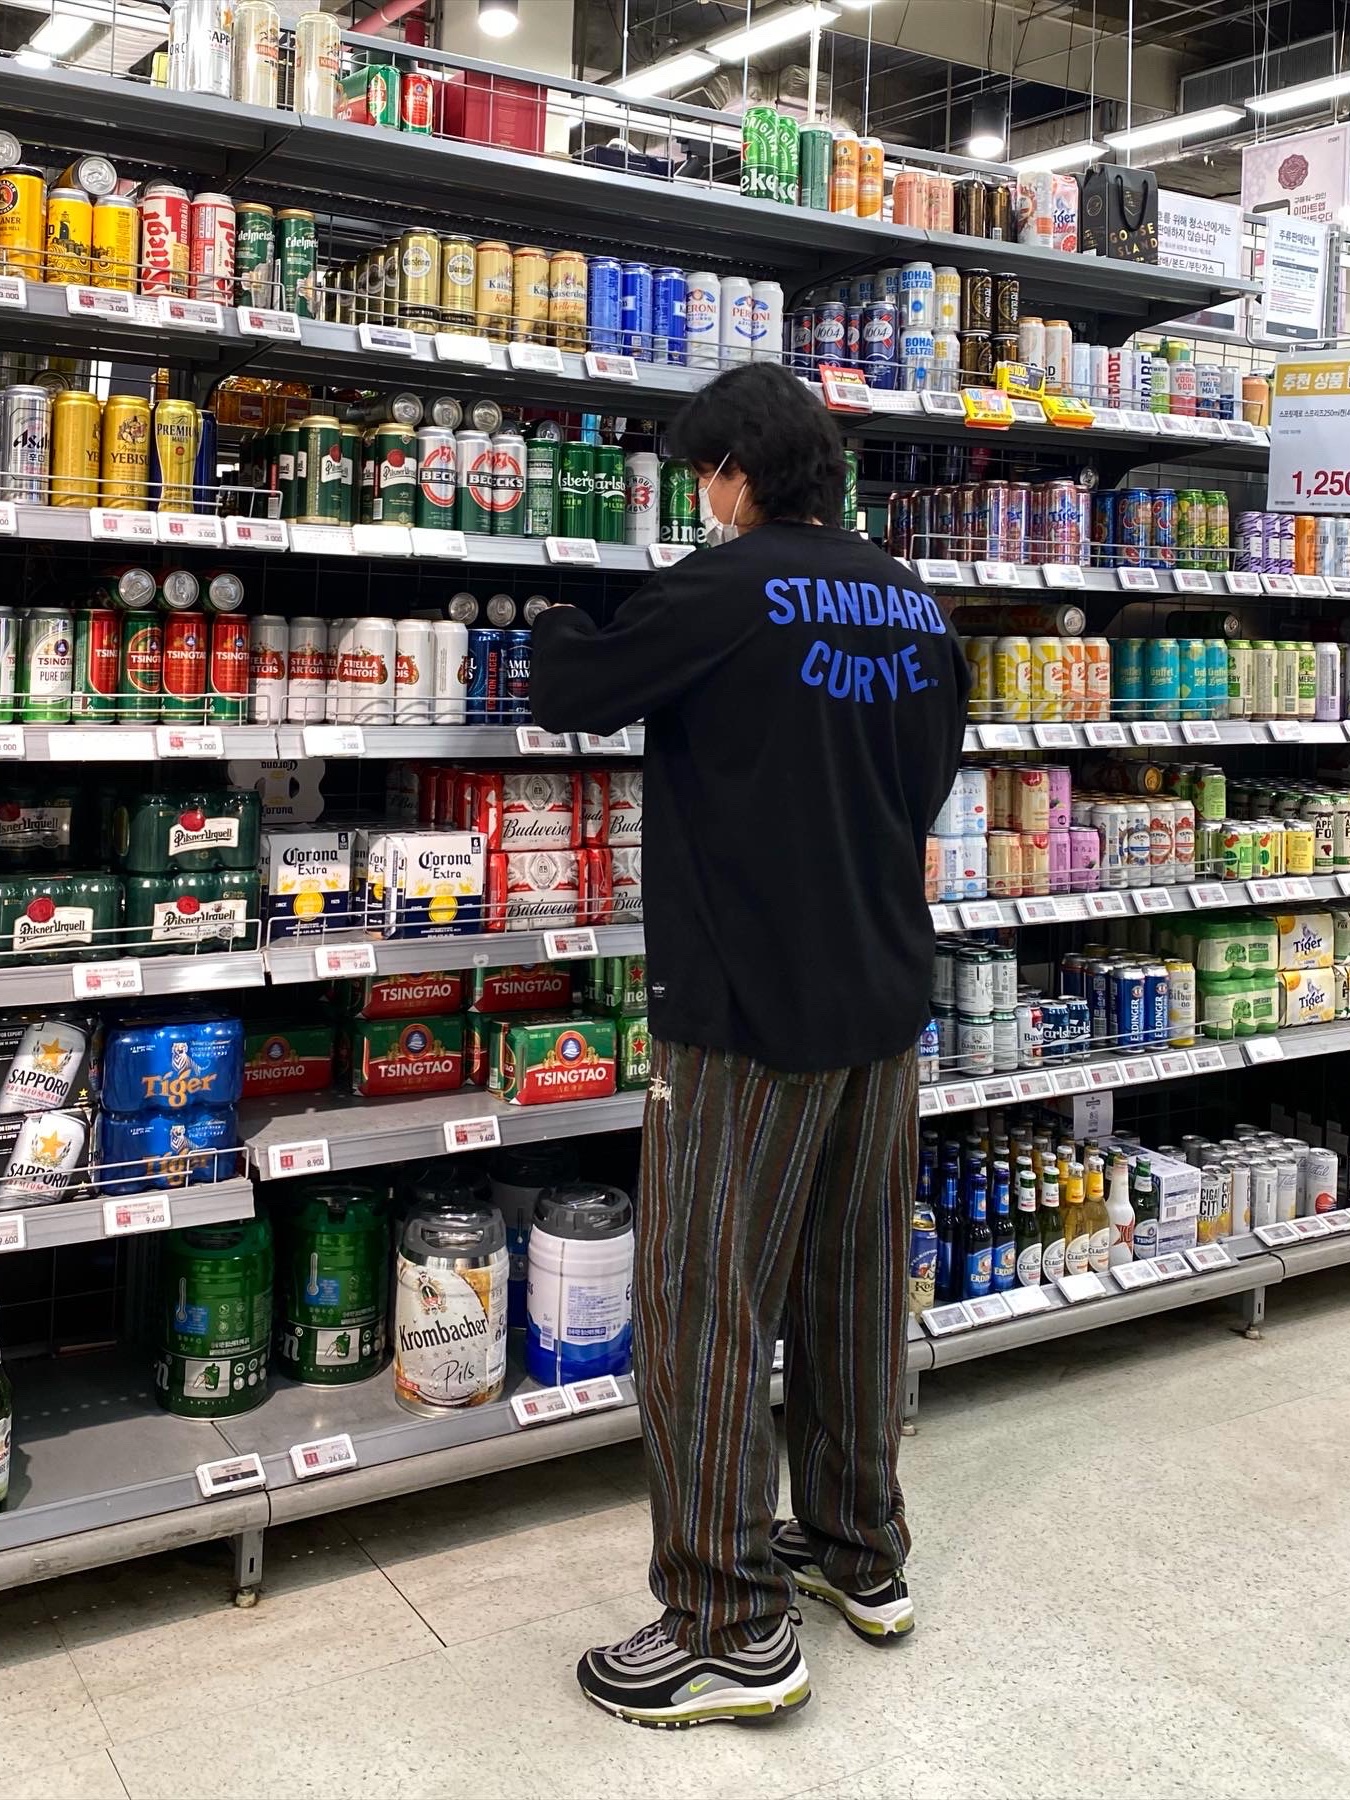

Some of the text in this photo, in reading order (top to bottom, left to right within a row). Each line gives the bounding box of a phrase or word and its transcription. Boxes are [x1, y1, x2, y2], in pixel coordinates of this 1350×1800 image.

[1188, 218, 1232, 236] 청소년에게는
[902, 270, 933, 282] BOHAE
[902, 281, 933, 289] SELTZER
[764, 576, 947, 635] STANDARD
[502, 818, 572, 839] Budweiser
[282, 847, 339, 868] Corona
[418, 850, 472, 871] Corona
[297, 863, 328, 876] Extra
[432, 867, 462, 879] Extra
[1293, 937, 1323, 956] Tiger
[380, 983, 452, 999] TSINGTAO
[492, 978, 562, 995] TSINGTAO
[1299, 992, 1326, 1011] Tiger
[245, 1064, 306, 1081] TSINGTAO
[378, 1060, 453, 1078] TSINGTAO
[534, 1067, 607, 1087] TSINGTAO
[8, 1068, 70, 1097] SAPPORO
[141, 1068, 218, 1109] Tiger
[399, 1317, 488, 1352] Krombacher
